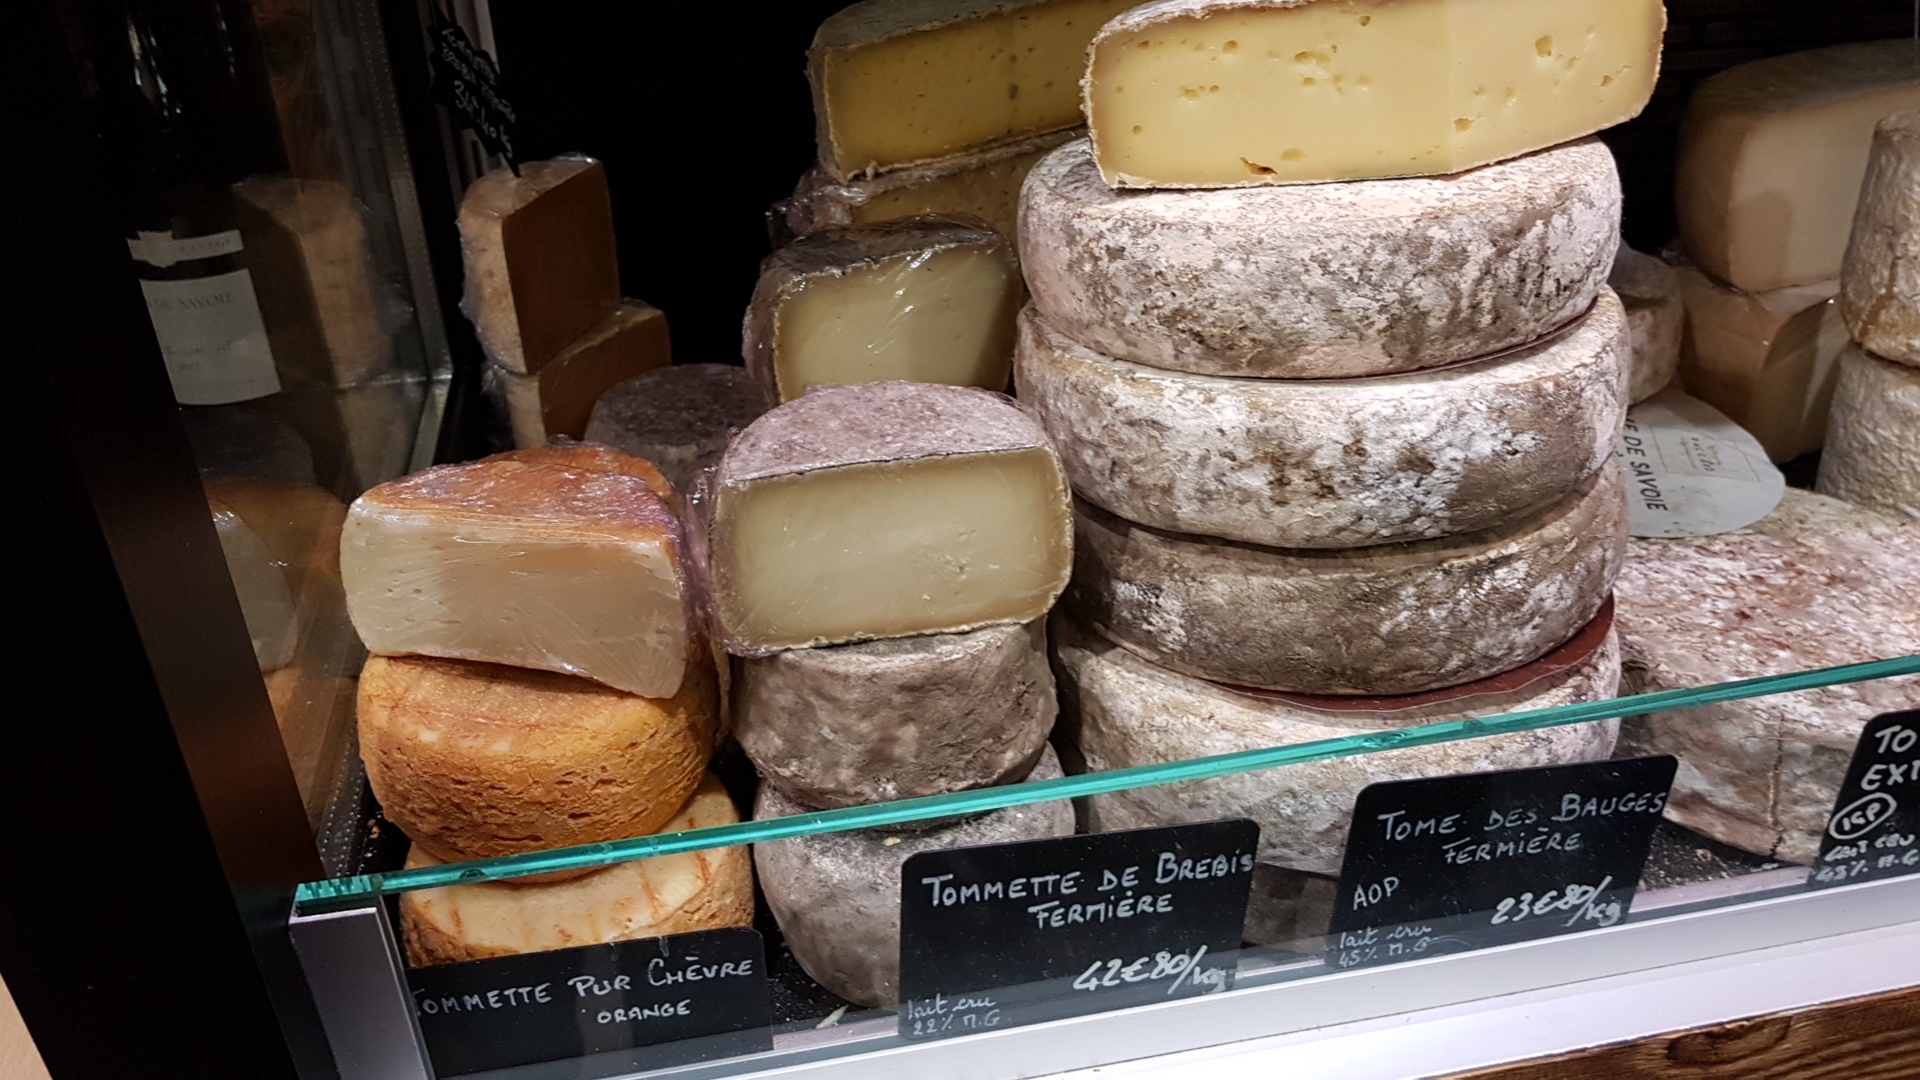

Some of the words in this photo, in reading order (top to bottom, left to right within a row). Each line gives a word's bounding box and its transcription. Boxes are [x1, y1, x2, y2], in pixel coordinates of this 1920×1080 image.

[1623, 435, 1647, 458] DE
[1630, 460, 1669, 512] SAVOIE
[1377, 810, 1462, 842] TOME
[1484, 808, 1537, 832] DES
[1552, 792, 1668, 822] BAUGES
[1841, 802, 1882, 832] IGP
[1442, 826, 1582, 865] FERMIÈRE
[922, 872, 1082, 907] TOMMETTE
[1097, 866, 1139, 892] DE
[1155, 851, 1255, 884] BREBIS
[1353, 876, 1400, 911] AOP
[1339, 928, 1378, 949] lait
[1386, 925, 1432, 940] cru
[567, 974, 632, 998] PUR
[647, 956, 754, 987] CHÈVRE
[597, 1000, 691, 1024] ORANGE
